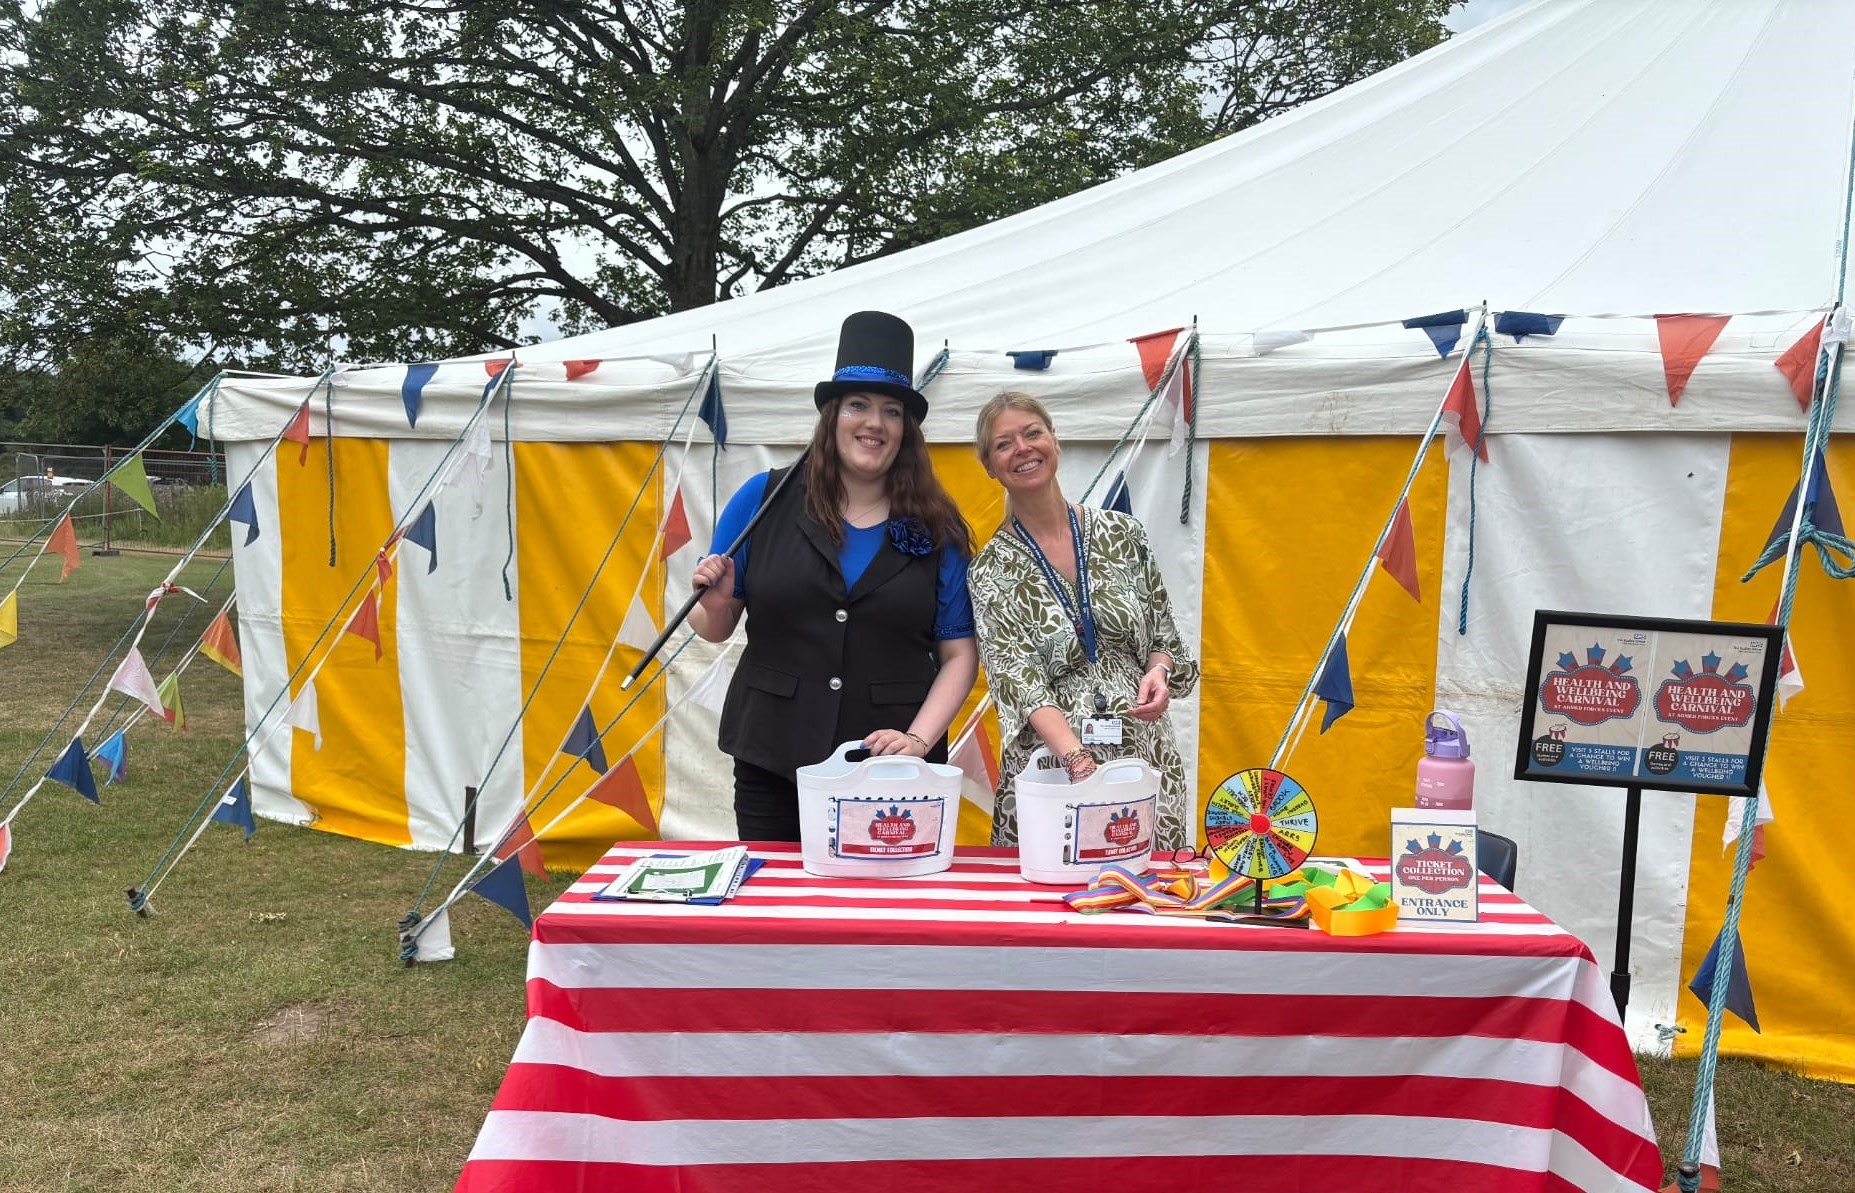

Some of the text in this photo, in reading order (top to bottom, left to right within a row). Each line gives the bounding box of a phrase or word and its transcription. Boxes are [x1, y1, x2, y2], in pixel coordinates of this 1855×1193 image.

[1553, 678, 1631, 690] HEALTH AND
[1556, 686, 1626, 698] WELLBEING
[1668, 686, 1746, 698] HEALTH AND
[1557, 695, 1619, 706] CARNIVAL
[1670, 694, 1741, 706] WELLBEING
[1671, 703, 1733, 714] CARNIVAL
[1535, 743, 1563, 752] FREE
[1648, 751, 1675, 761] FREE
[1270, 789, 1290, 810] BROOK
[1273, 806, 1288, 817] HOME
[1287, 800, 1308, 814] INSTEAD
[1280, 818, 1308, 826] THRIVE
[1403, 867, 1464, 875] COLLECTION
[1402, 898, 1468, 908] ENTRANCE
[1417, 907, 1449, 916] ONLY
